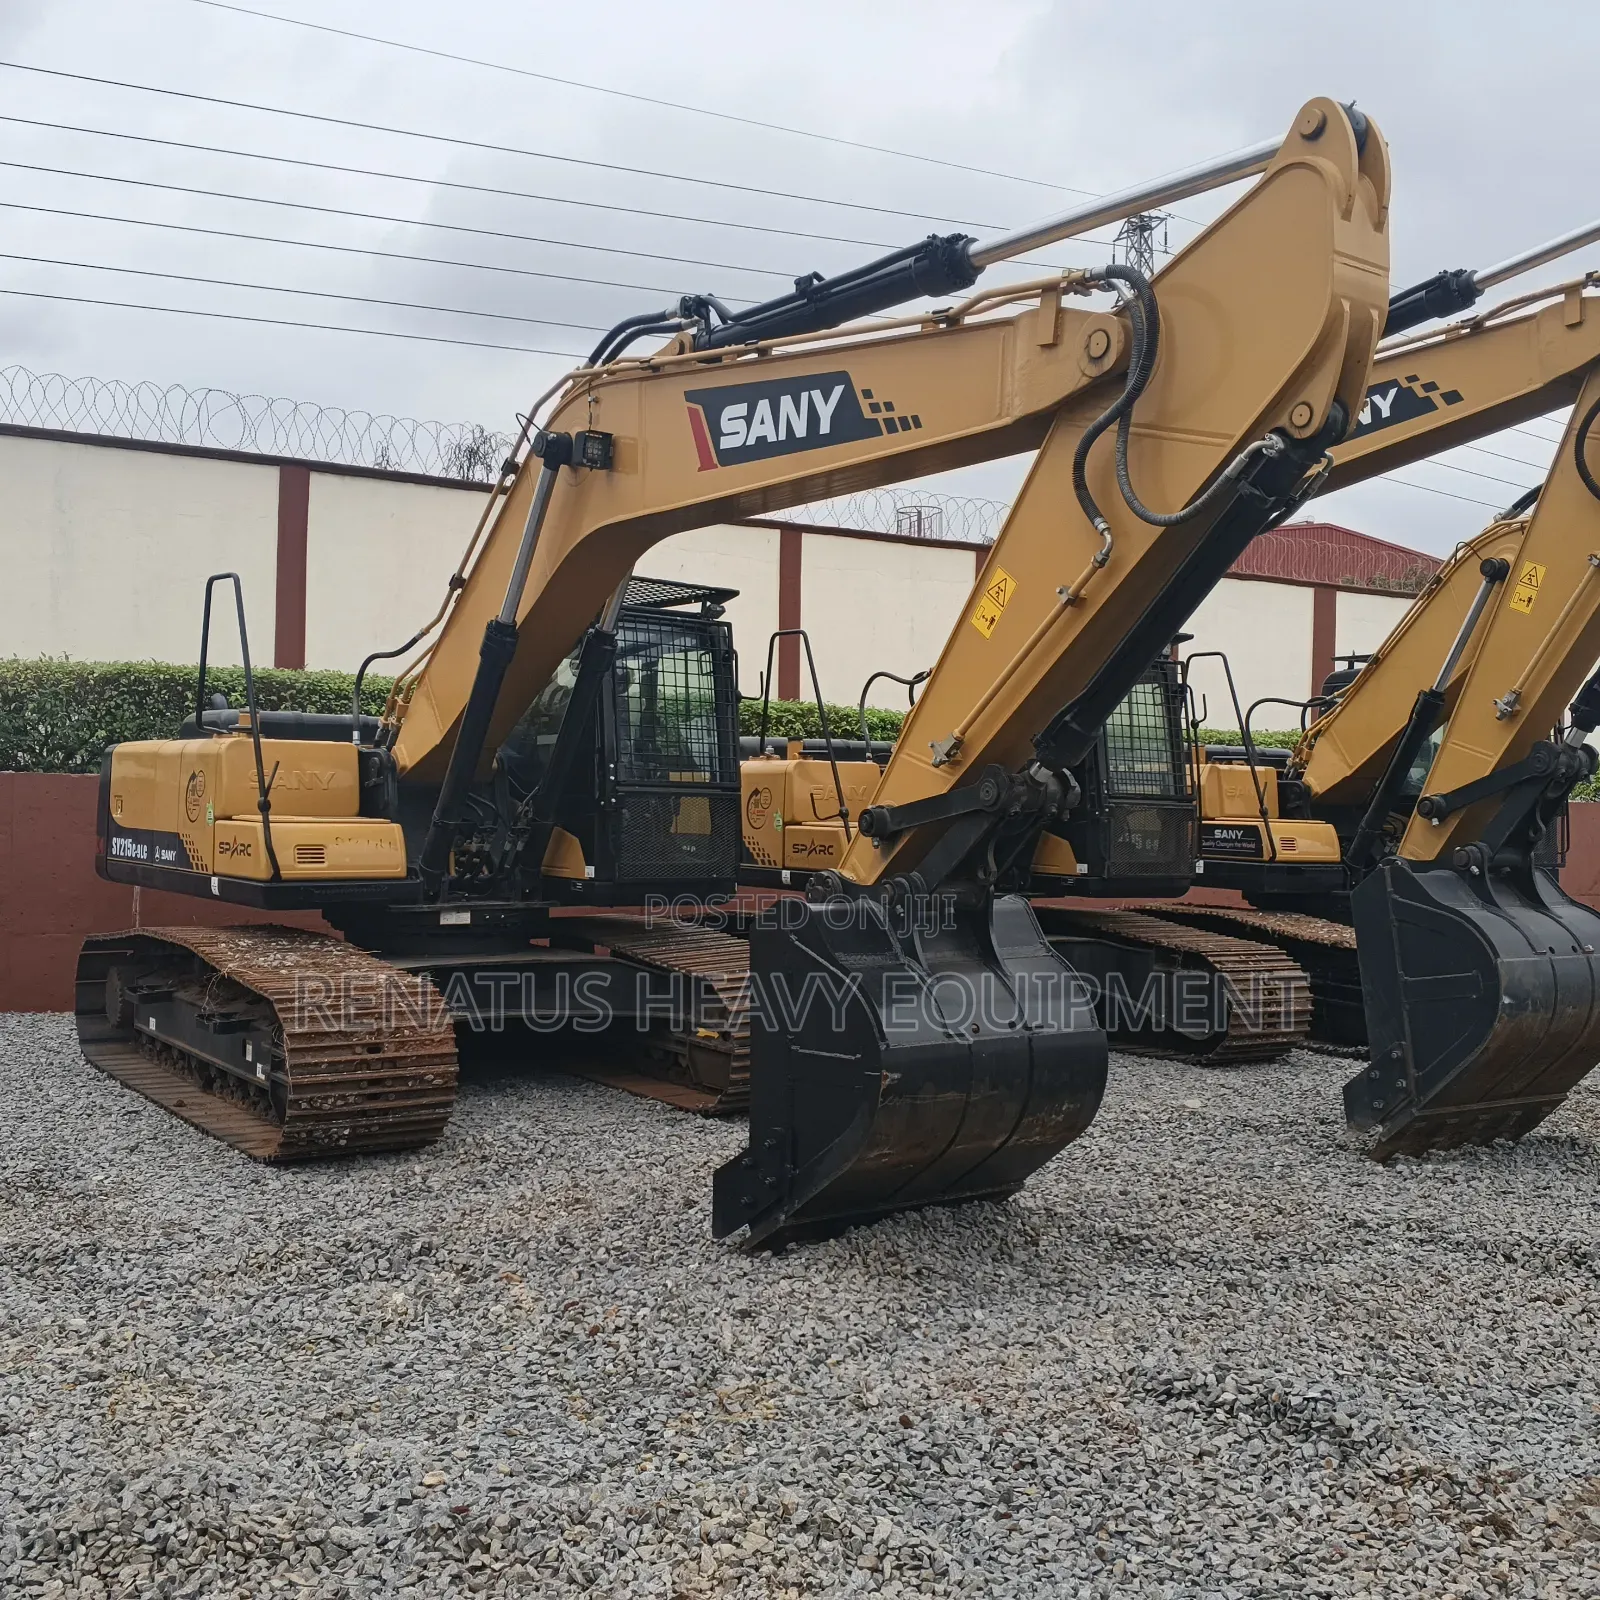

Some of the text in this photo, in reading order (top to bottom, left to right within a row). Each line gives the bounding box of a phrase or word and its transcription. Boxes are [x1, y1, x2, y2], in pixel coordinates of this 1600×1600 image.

[719, 384, 846, 450] SANY
[248, 769, 336, 791] SANY
[1214, 829, 1244, 840] SANY
[1242, 841, 1256, 849] World
[160, 849, 177, 862] SANY
[218, 835, 252, 860] SPARC
[792, 837, 834, 858] SPARC
